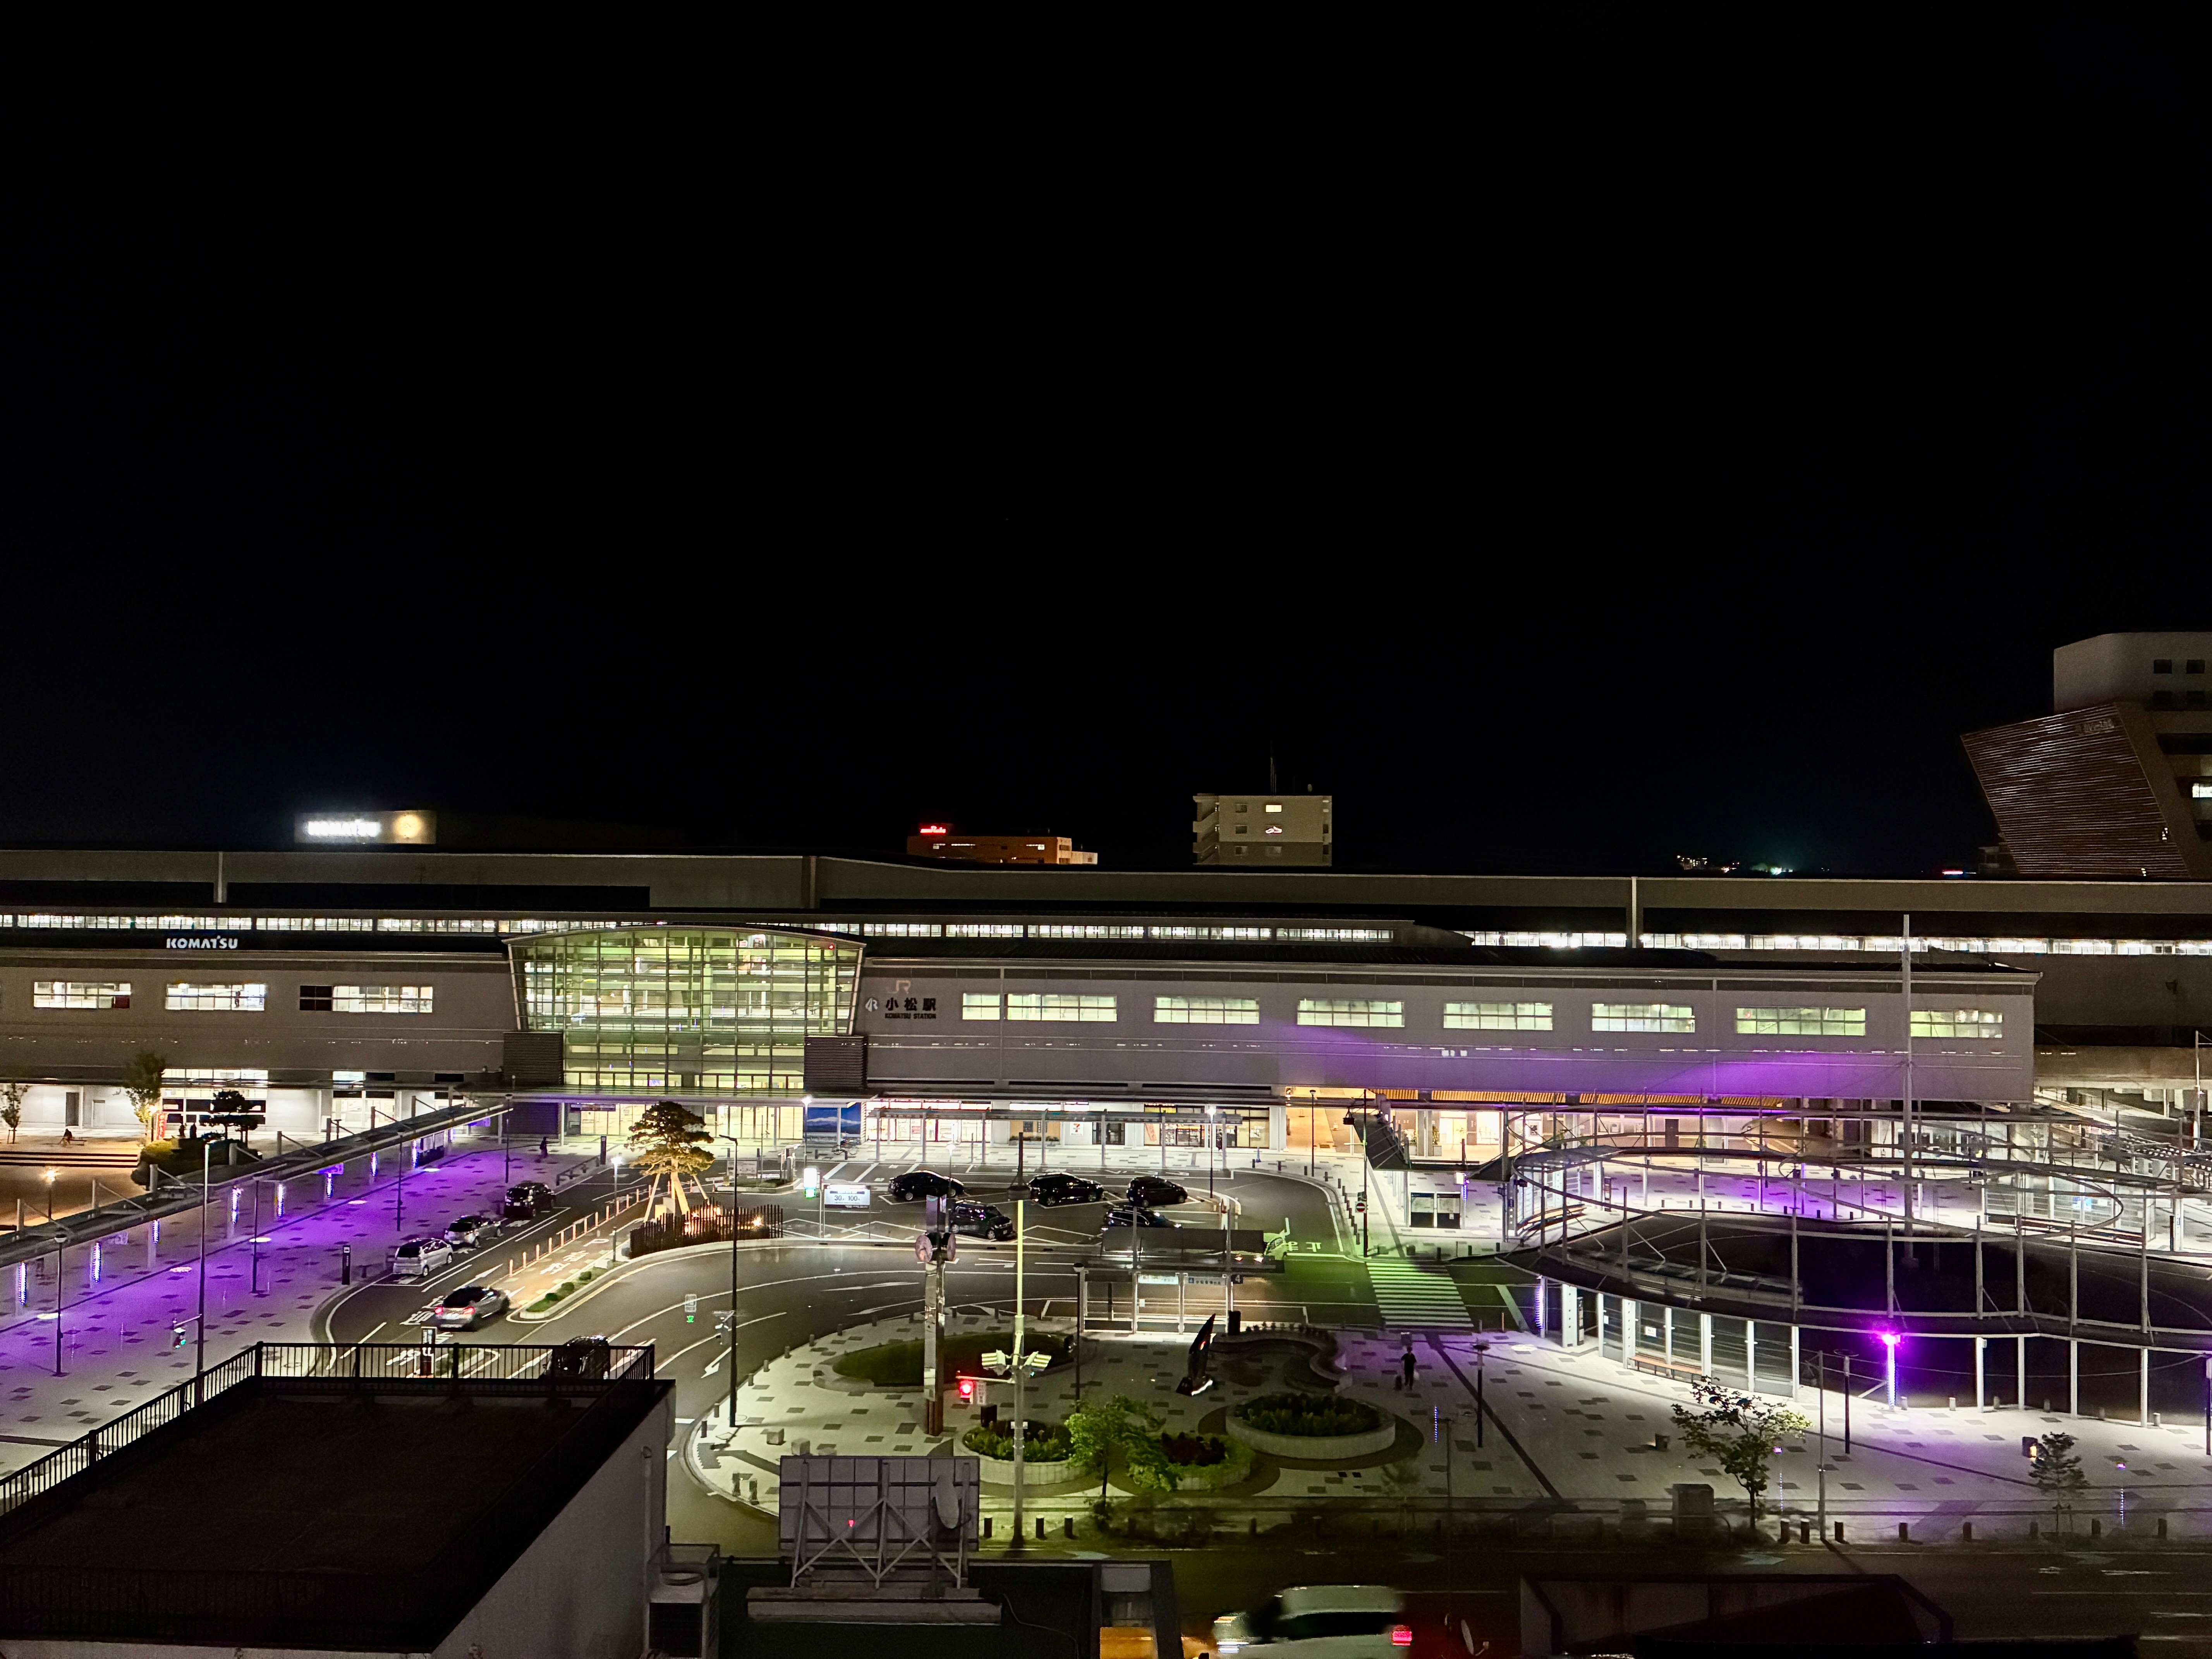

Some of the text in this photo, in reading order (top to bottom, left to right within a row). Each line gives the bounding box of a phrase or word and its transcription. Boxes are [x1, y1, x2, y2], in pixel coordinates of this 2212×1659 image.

[166, 935, 238, 949] KOMATSU
[886, 997, 936, 1011] 小松駅
[1235, 1275, 1240, 1283] 4
